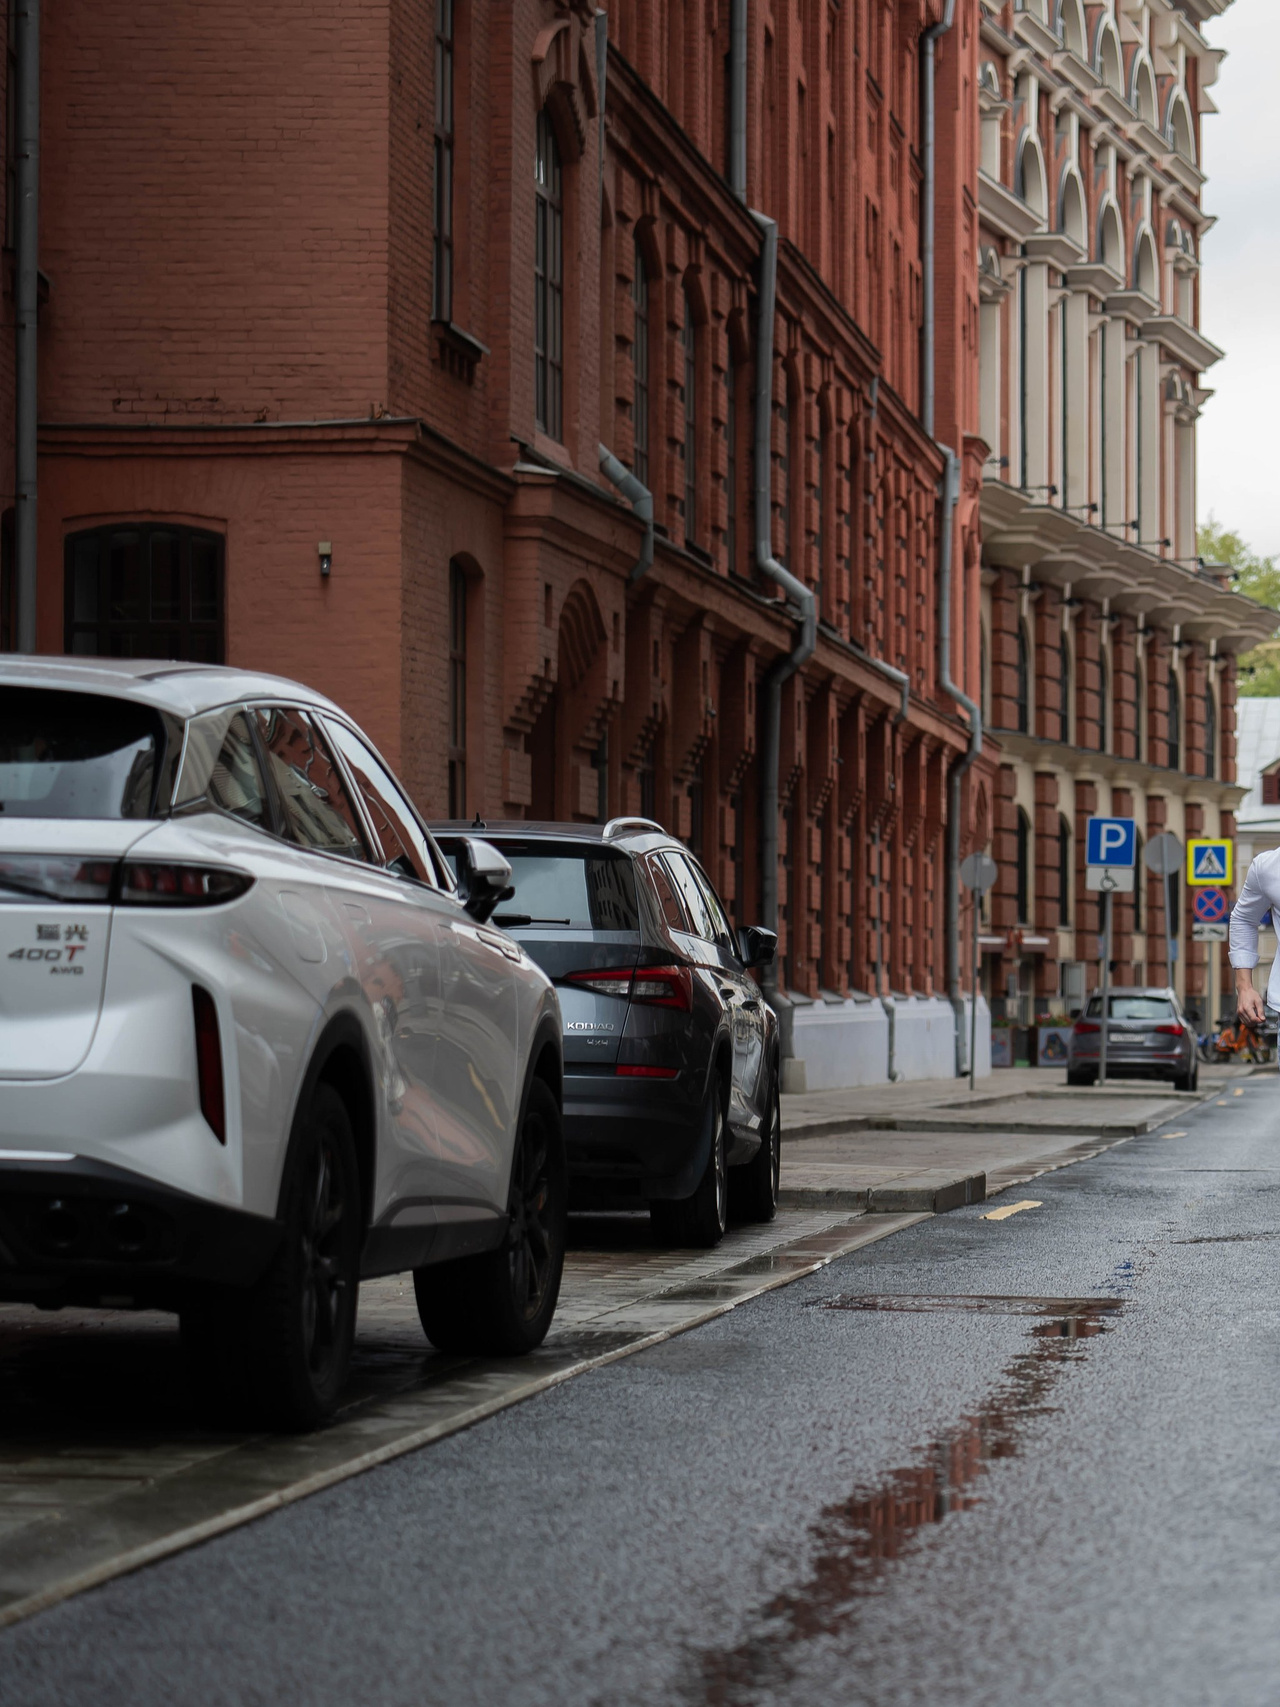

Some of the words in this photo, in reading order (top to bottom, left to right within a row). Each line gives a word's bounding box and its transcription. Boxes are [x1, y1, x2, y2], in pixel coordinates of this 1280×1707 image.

[1100, 823, 1127, 861] P
[8, 945, 86, 962] 400T
[567, 1022, 614, 1031] KODIAQ
